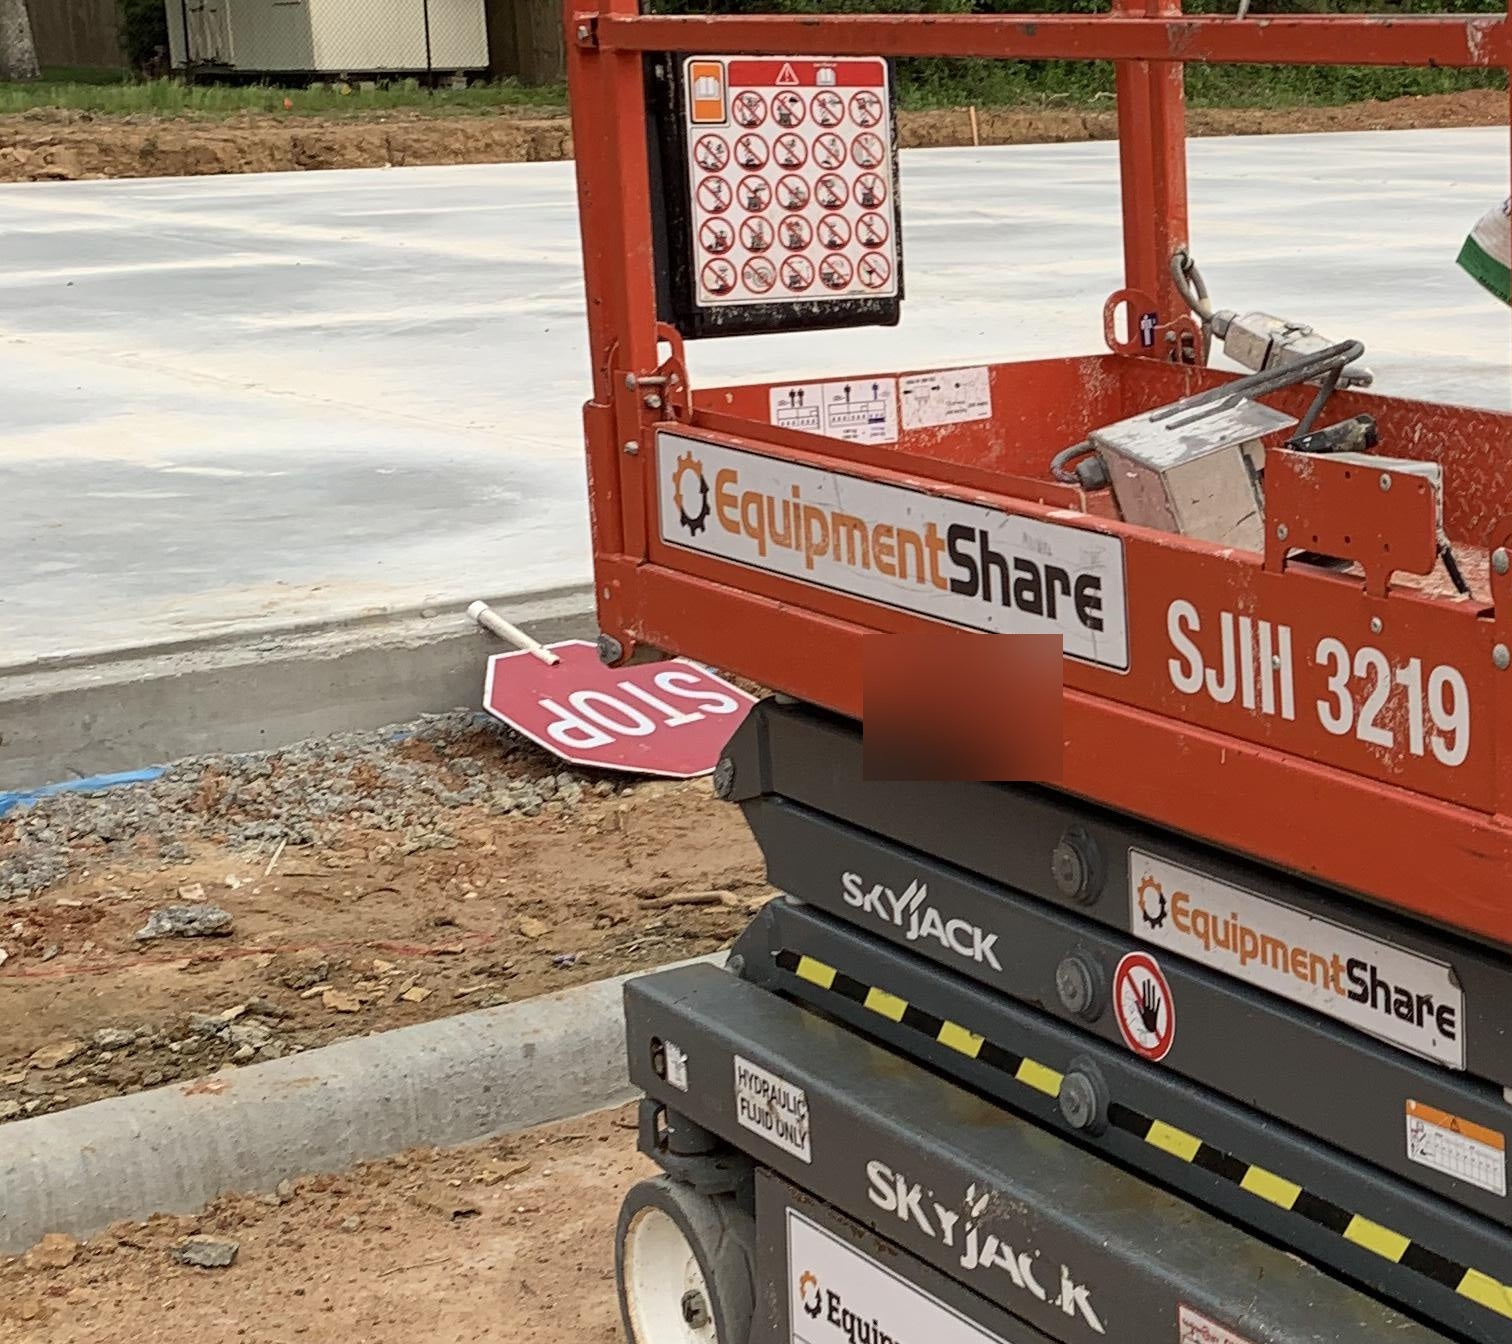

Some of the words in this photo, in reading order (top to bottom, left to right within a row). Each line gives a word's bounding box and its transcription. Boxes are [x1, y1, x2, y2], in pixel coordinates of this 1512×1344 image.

[715, 467, 1104, 632] EquipmentShare
[538, 671, 739, 749] STOP
[1166, 599, 1296, 722] SJIII
[1315, 637, 1471, 767] 3219
[841, 870, 1003, 971] SKYJACK
[1169, 889, 1457, 1041] EquipmentShare
[738, 1065, 806, 1119] HYDRAULIC
[740, 1097, 774, 1131] FLUID
[776, 1117, 808, 1150] ONLY
